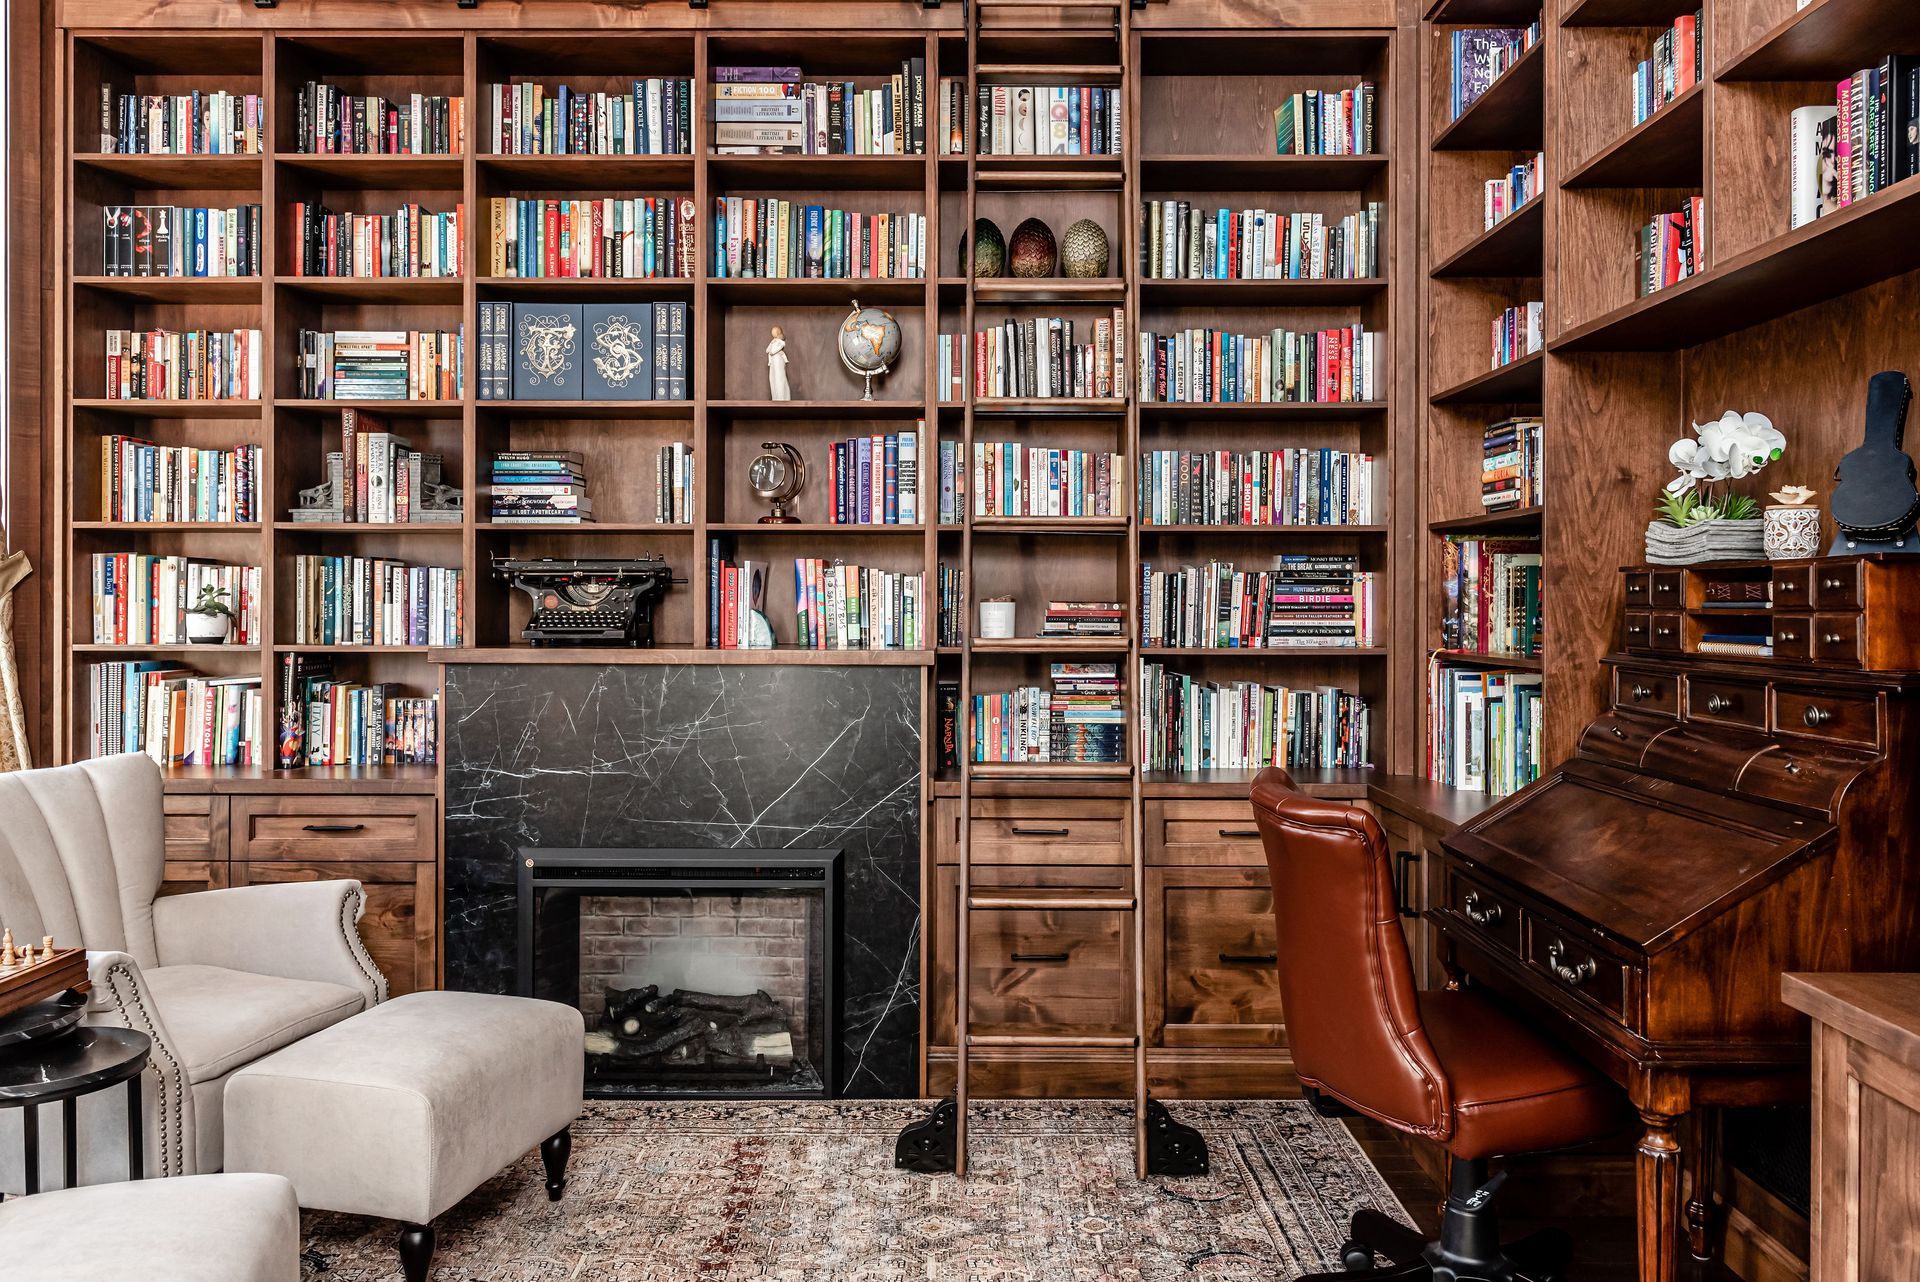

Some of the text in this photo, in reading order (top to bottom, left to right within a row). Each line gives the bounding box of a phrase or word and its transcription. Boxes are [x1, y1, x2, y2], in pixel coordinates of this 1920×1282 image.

[1474, 38, 1497, 49] The
[734, 86, 756, 94] FICTION
[914, 74, 922, 102] poetry
[894, 98, 902, 136] MYTHOLOGY
[980, 104, 988, 137] Roddy Doyle
[1851, 76, 1862, 142] MARGARET
[729, 237, 738, 264] Fayne
[1166, 243, 1174, 277] QUEEN
[1192, 226, 1200, 274] INSURGENT
[1648, 220, 1658, 294] ZADIE SMITH
[1026, 342, 1034, 366] Journey
[1158, 350, 1166, 360] LIKE
[1328, 338, 1336, 360] NESS
[1158, 366, 1166, 378] LOVE
[1158, 380, 1166, 396] STORY
[874, 452, 882, 508] THE HANDMAID'S TALE
[1180, 455, 1188, 485] WOOL
[862, 463, 870, 515] GEORGE SAUNDERS
[1244, 482, 1252, 512] SHOUT
[1142, 566, 1150, 594] LOUISE
[1288, 562, 1312, 570] THE BREAK
[106, 576, 114, 592] Boy!
[1300, 594, 1330, 602] BIRDIE
[204, 700, 212, 748] SPEEDY YOGA
[312, 705, 321, 736] ITALY
[944, 718, 952, 753] NARNIA
[1020, 718, 1028, 752] INKLING
